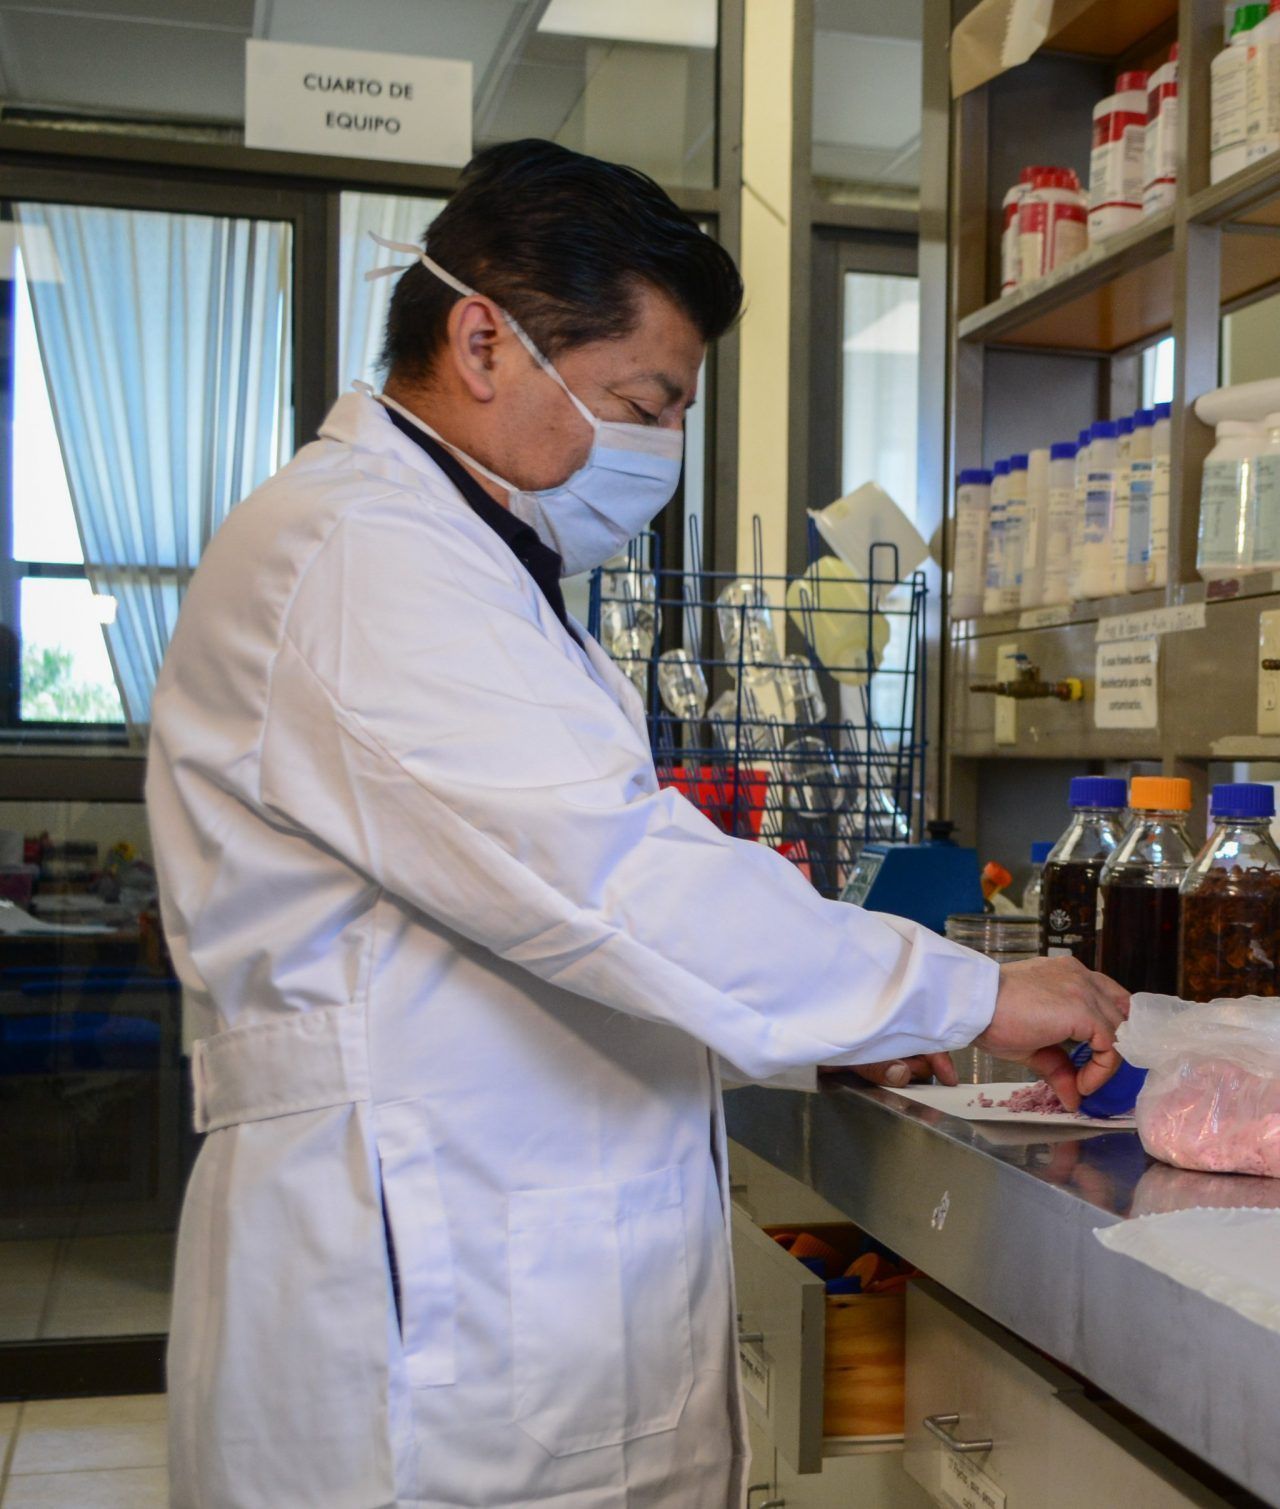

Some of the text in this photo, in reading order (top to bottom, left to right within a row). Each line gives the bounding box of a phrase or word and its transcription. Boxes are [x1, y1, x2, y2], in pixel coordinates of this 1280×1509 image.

[303, 73, 414, 100] CUARTO DE
[325, 111, 402, 135] EQUIPO
